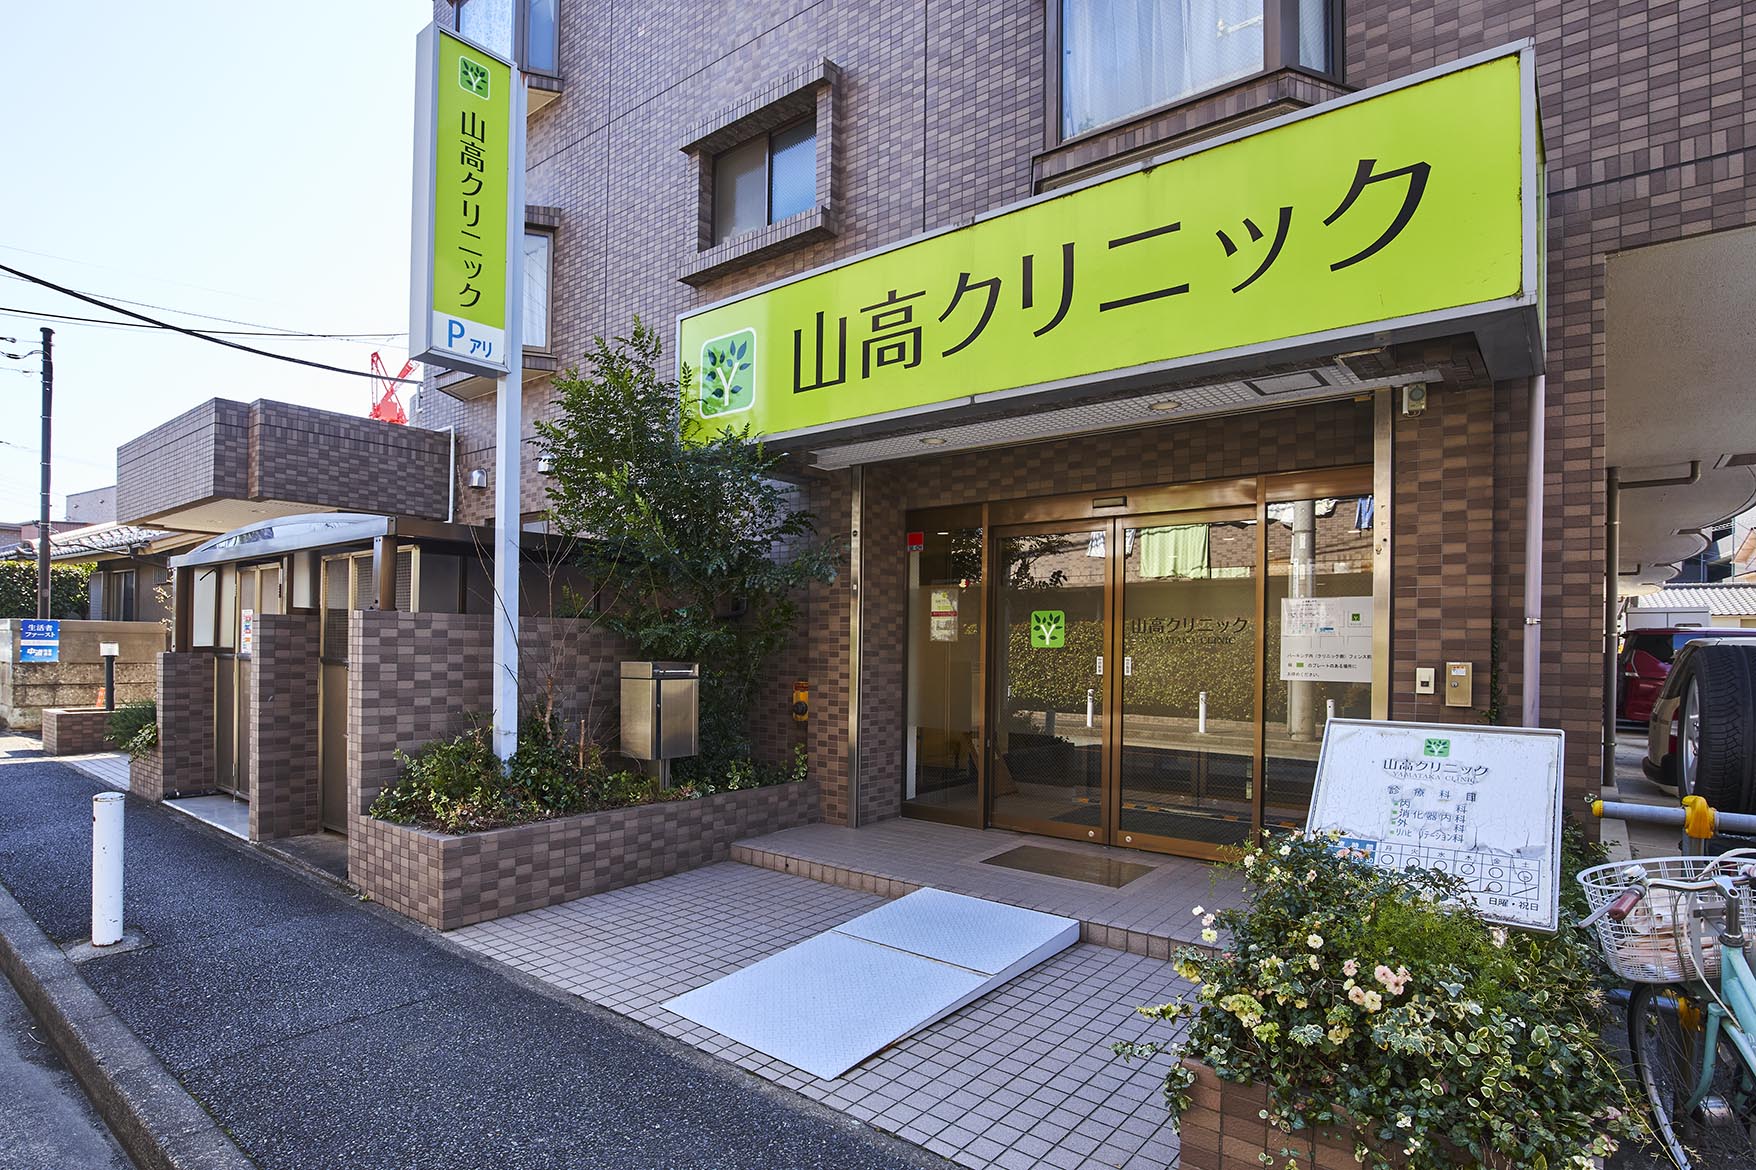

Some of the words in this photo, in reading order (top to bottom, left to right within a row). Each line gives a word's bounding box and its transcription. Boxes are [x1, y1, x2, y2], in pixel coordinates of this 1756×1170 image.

[458, 111, 486, 308] 山高クリニック
[793, 158, 1432, 394] 山高クリニック
[28, 624, 53, 632] 生活者
[1131, 616, 1248, 634] 山高クリニック
[1200, 637, 1236, 645] CLINIC
[1383, 758, 1489, 777] 山高クリニック
[1392, 771, 1441, 781] YAMATAKA
[1493, 857, 1501, 865] 金
